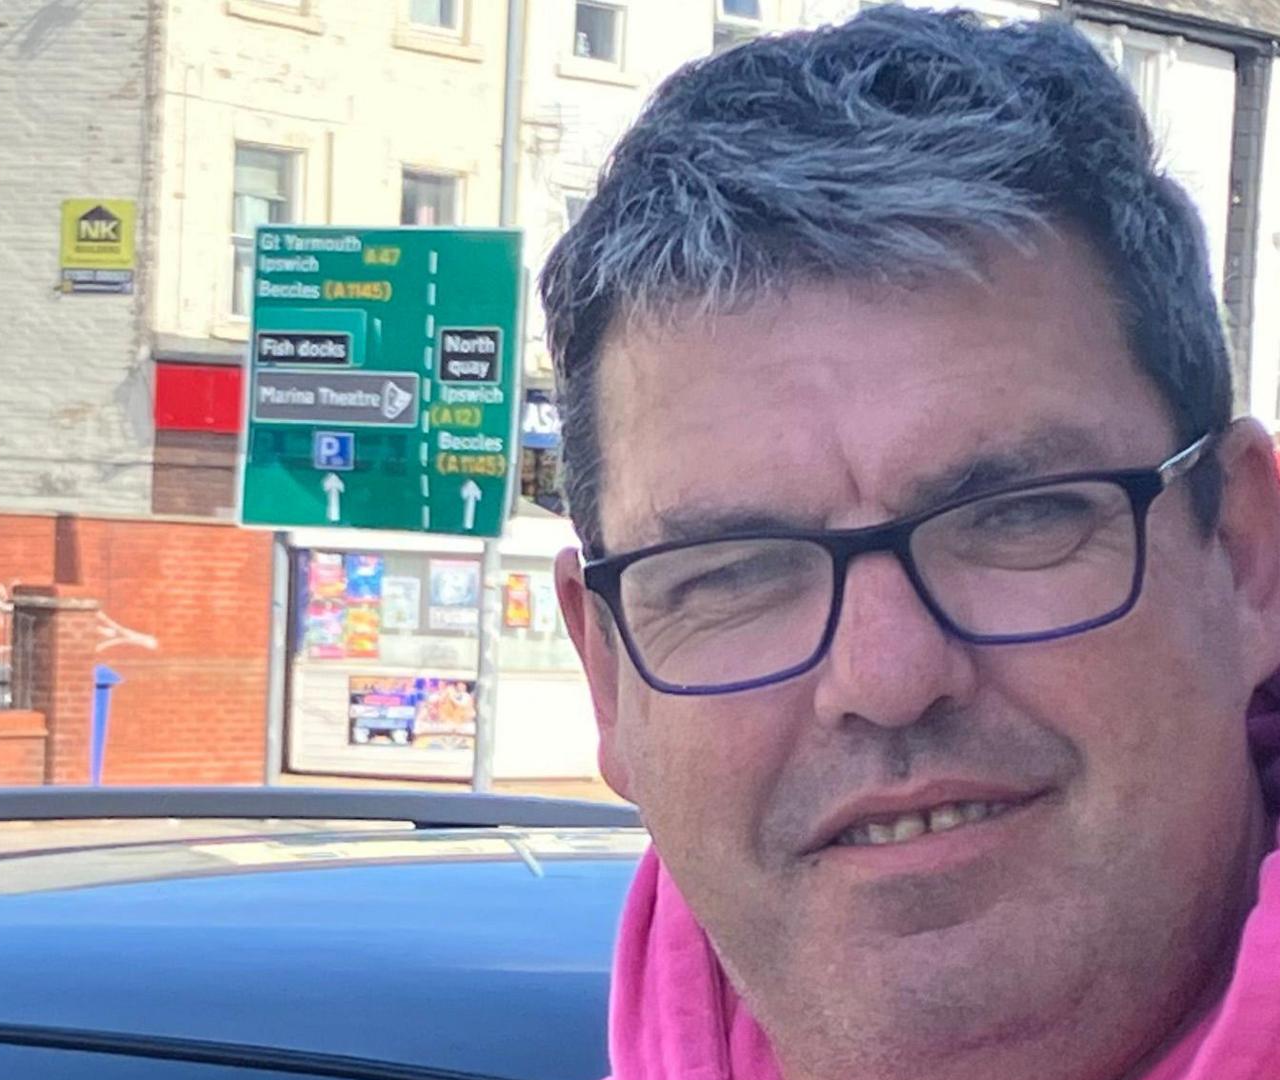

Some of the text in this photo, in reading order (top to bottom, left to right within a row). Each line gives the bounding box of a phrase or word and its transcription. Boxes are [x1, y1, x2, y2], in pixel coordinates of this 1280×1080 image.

[80, 219, 118, 240] NK
[260, 233, 362, 252] Gt Yarmouth
[260, 254, 320, 273] Ipswich
[258, 280, 320, 299] Beccles
[261, 338, 346, 358] Fish docks
[444, 334, 496, 354] North
[447, 360, 490, 379] quay
[259, 386, 382, 407] Marina Theatre
[440, 385, 504, 404] Ipswich
[438, 431, 504, 452] Beccles
